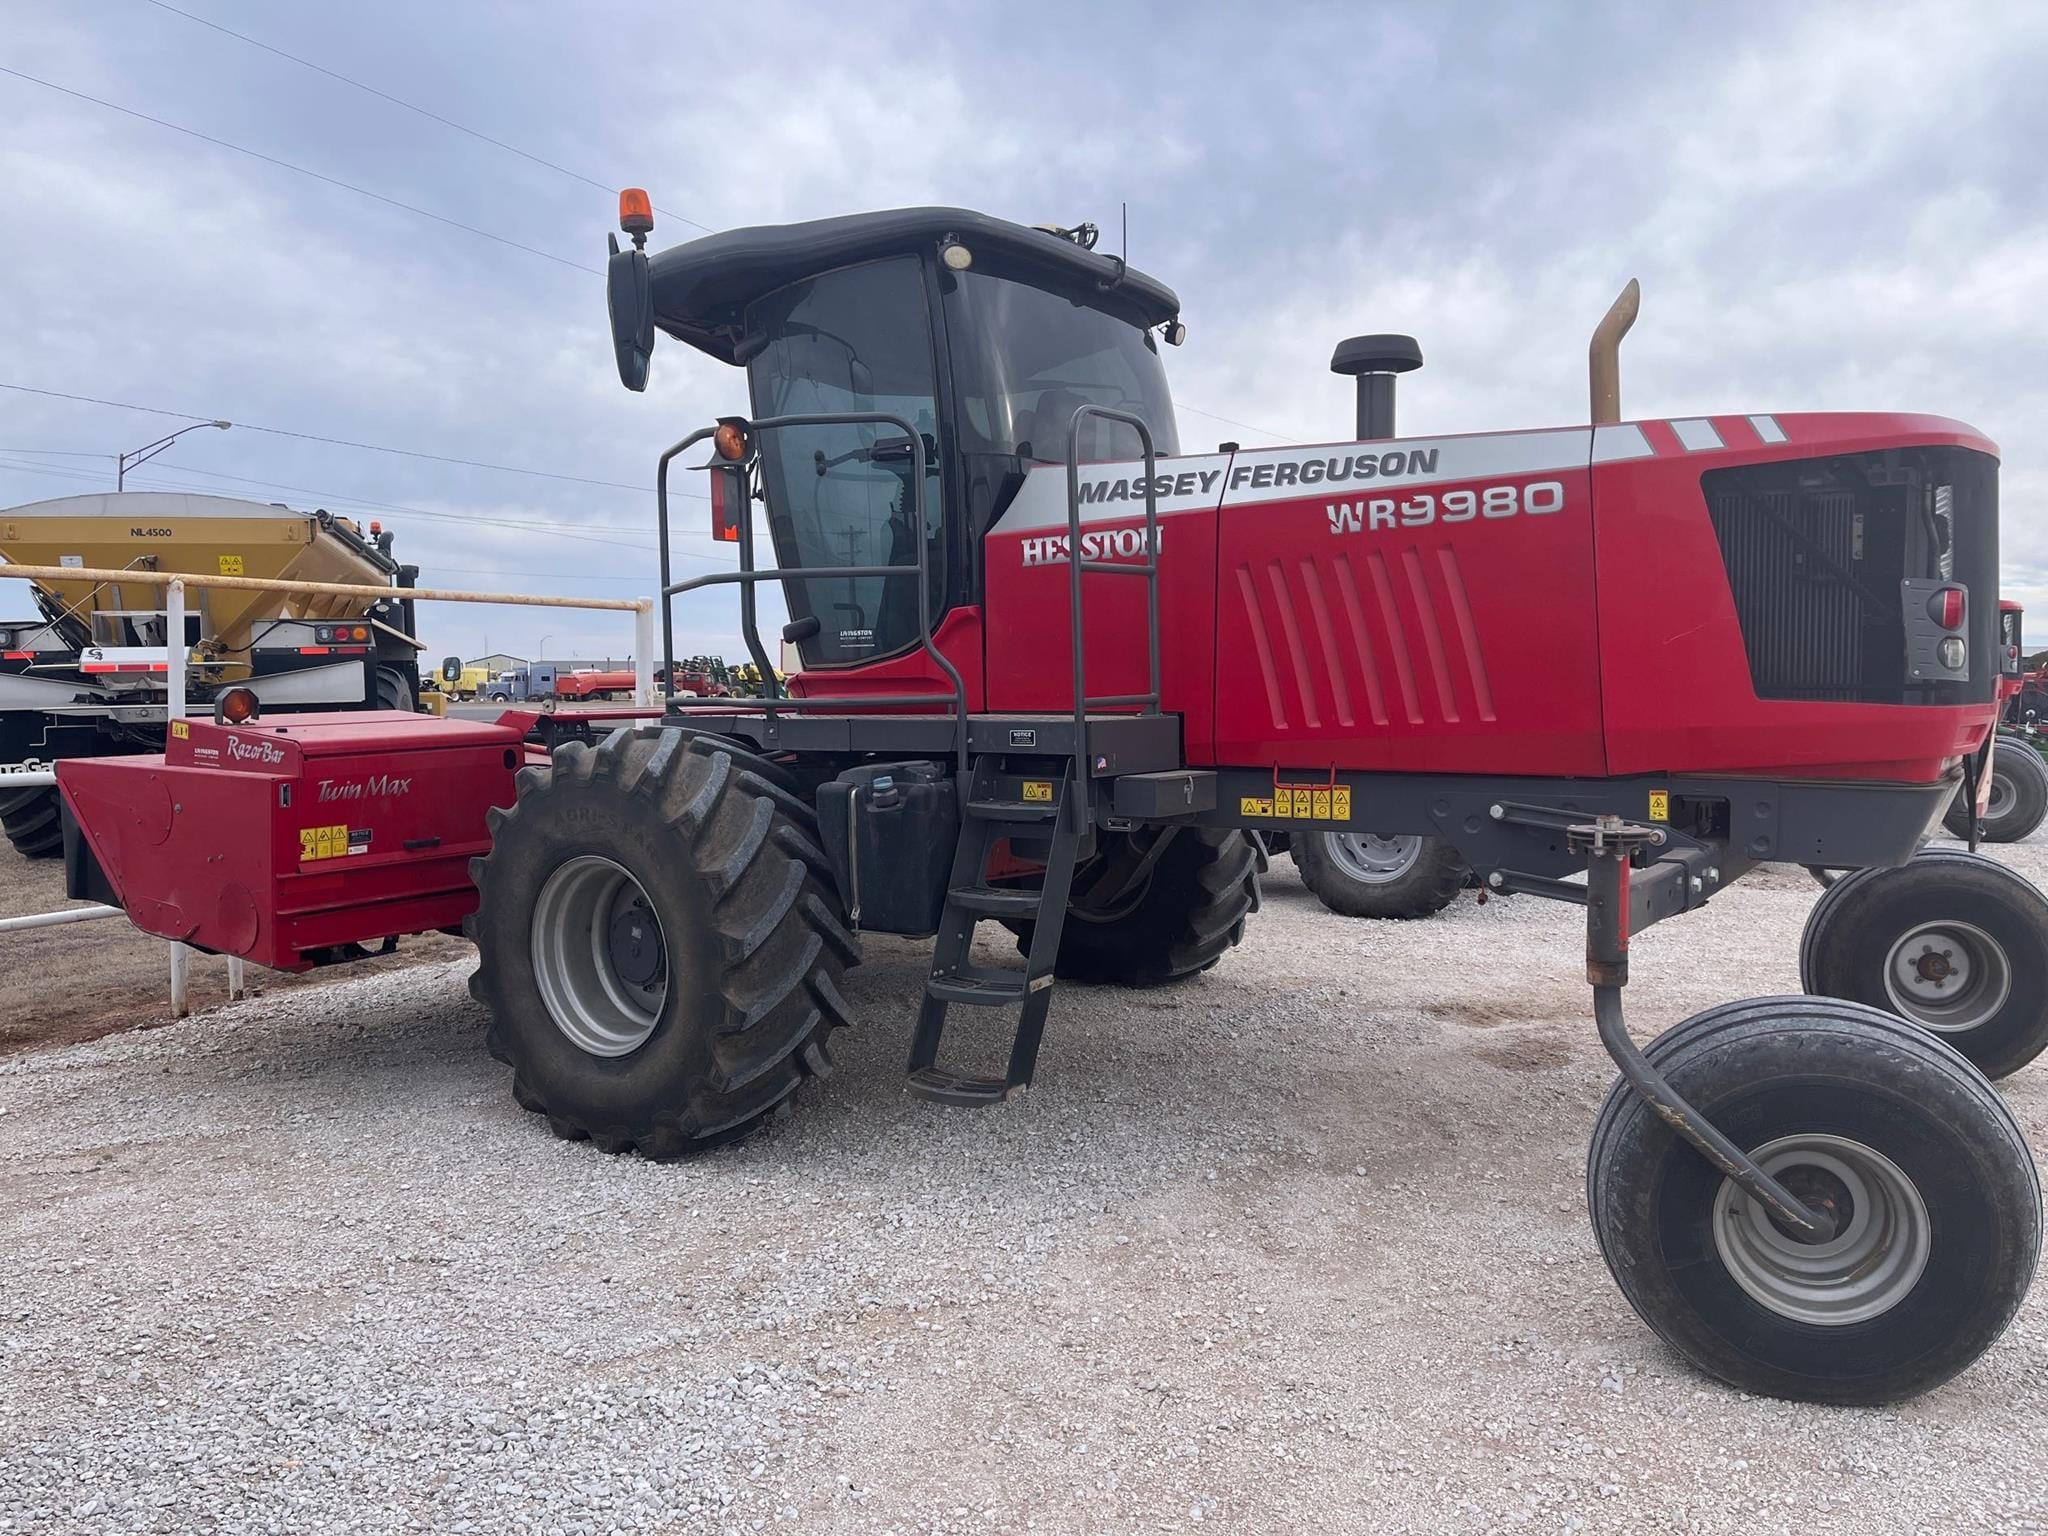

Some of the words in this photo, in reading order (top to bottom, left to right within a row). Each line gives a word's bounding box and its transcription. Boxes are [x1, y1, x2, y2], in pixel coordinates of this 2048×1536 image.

[1078, 470, 1221, 504] MASSEY
[1229, 448, 1440, 491] FERGUSON
[1326, 481, 1565, 535] WR9980
[130, 528, 173, 537] NL4500
[318, 779, 362, 803] Twin
[363, 774, 413, 798] Max
